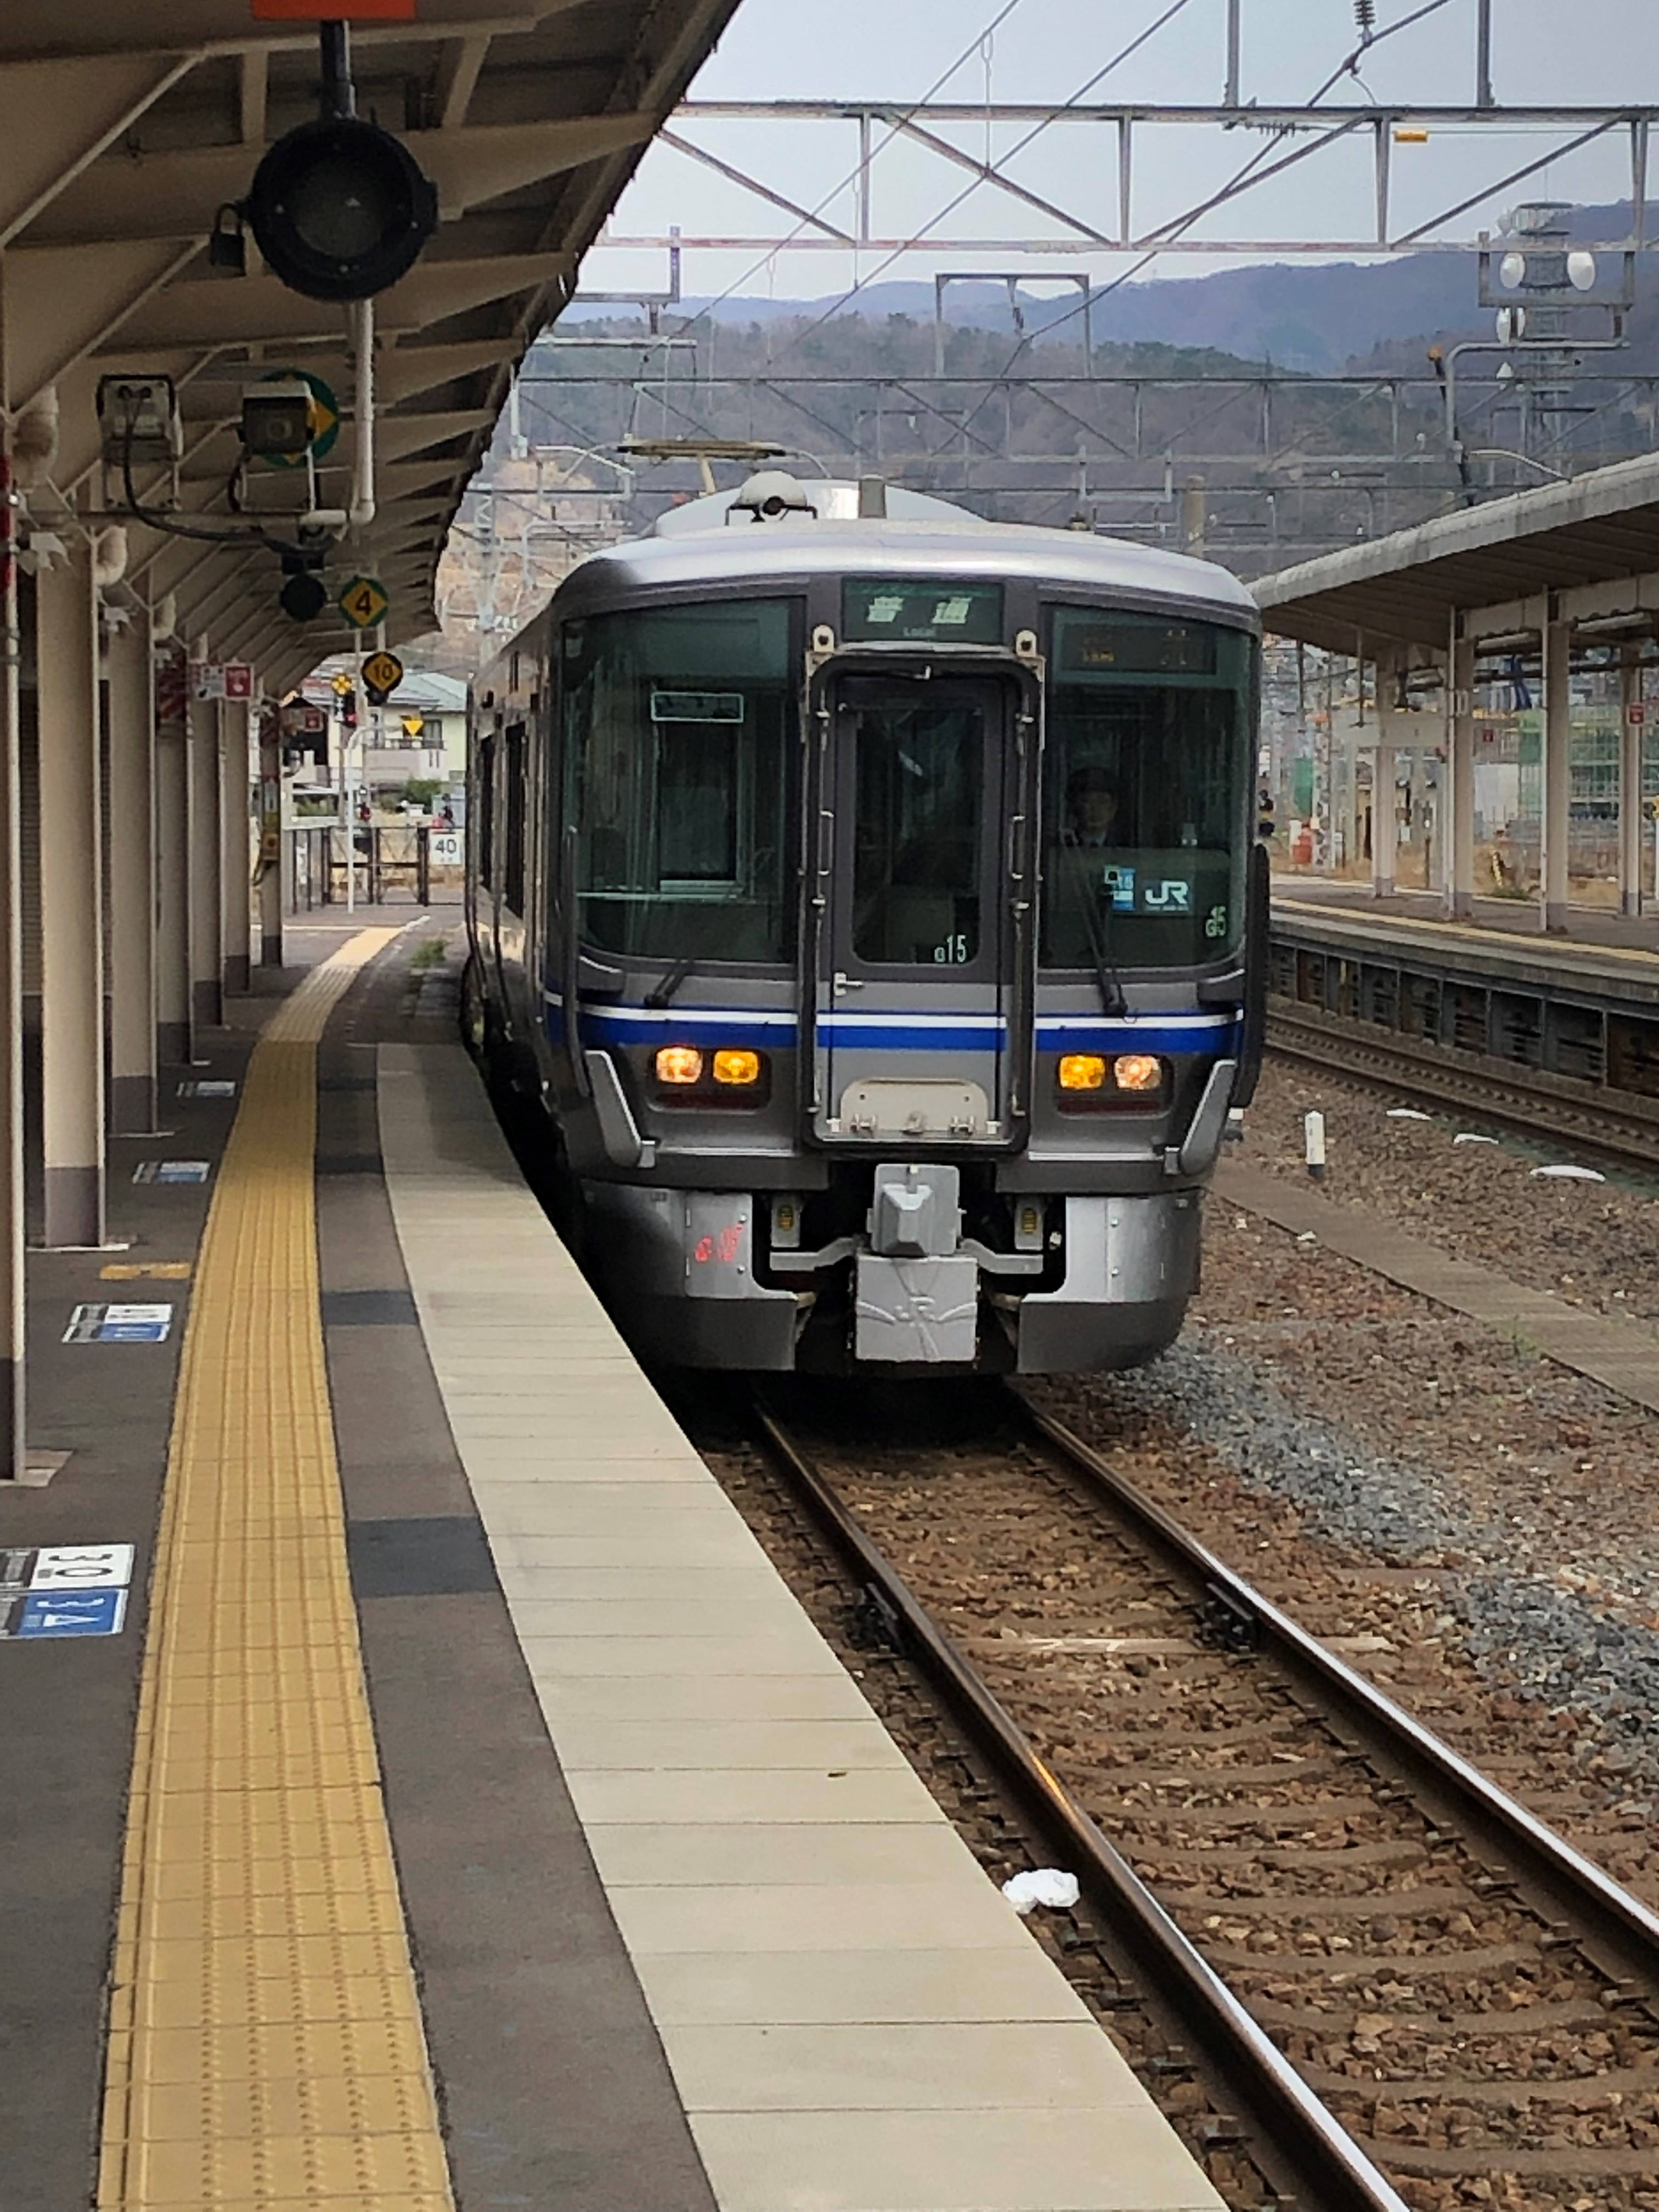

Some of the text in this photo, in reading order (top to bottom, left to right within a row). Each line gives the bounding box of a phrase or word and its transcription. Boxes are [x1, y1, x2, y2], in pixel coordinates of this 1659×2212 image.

[356, 590, 372, 616] 4
[374, 664, 393, 680] 10
[435, 839, 456, 854] 40
[1145, 881, 1189, 904] JR
